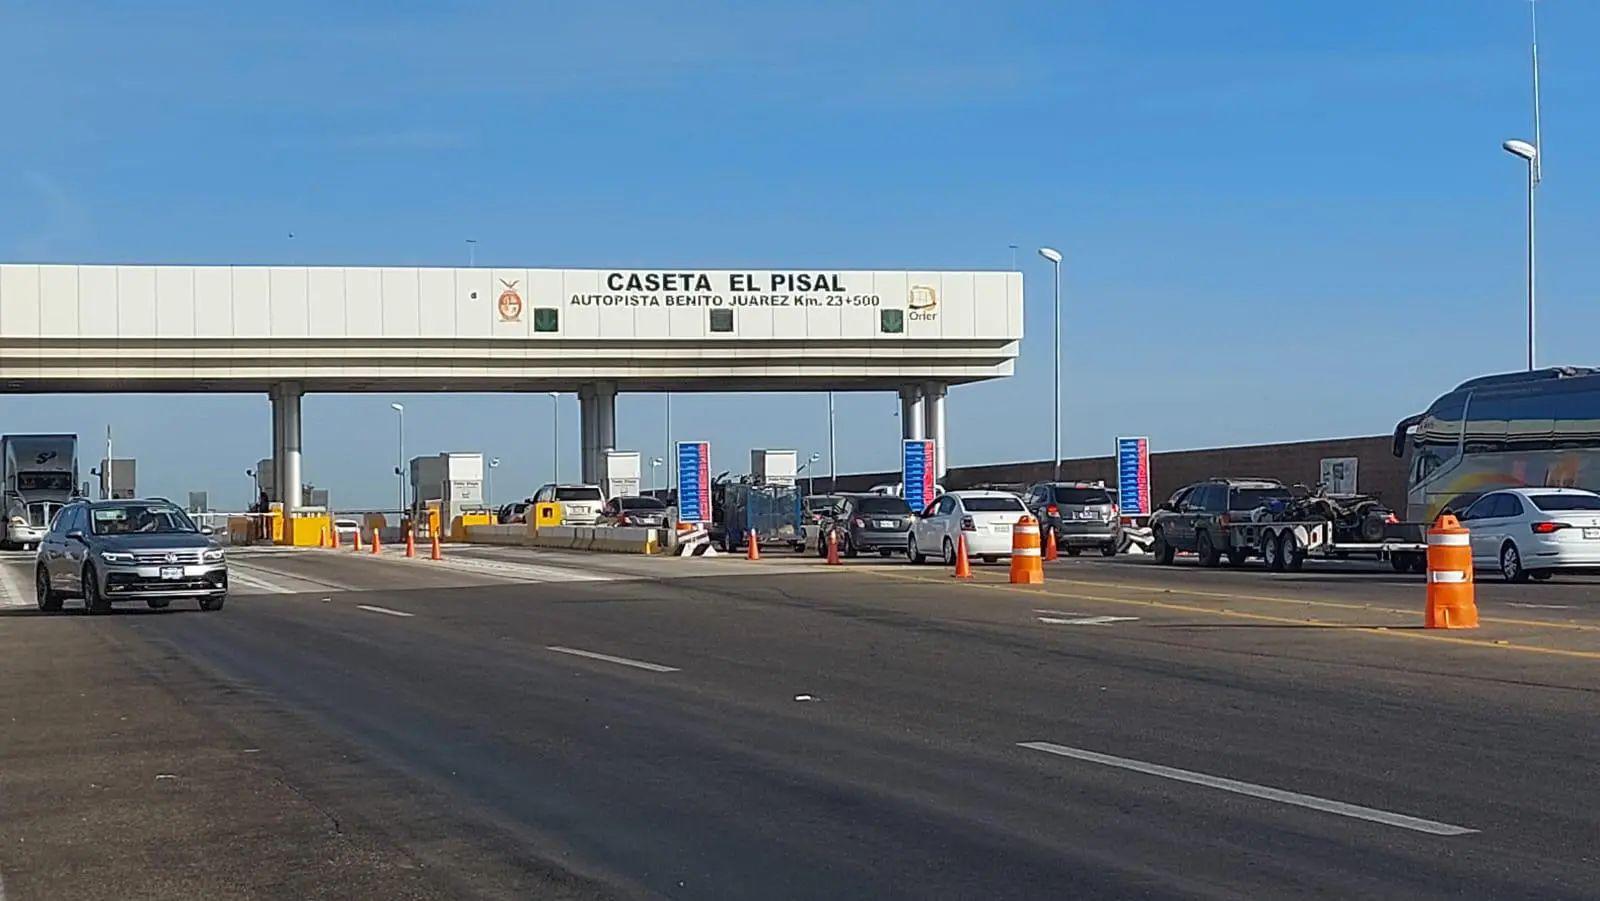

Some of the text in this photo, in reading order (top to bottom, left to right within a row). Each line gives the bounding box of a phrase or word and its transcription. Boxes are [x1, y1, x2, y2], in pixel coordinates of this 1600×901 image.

[607, 273, 846, 292] CASETA EL PISAL
[570, 294, 880, 307] AUTOPISTA BENITO JUAREZ Km. 23+500
